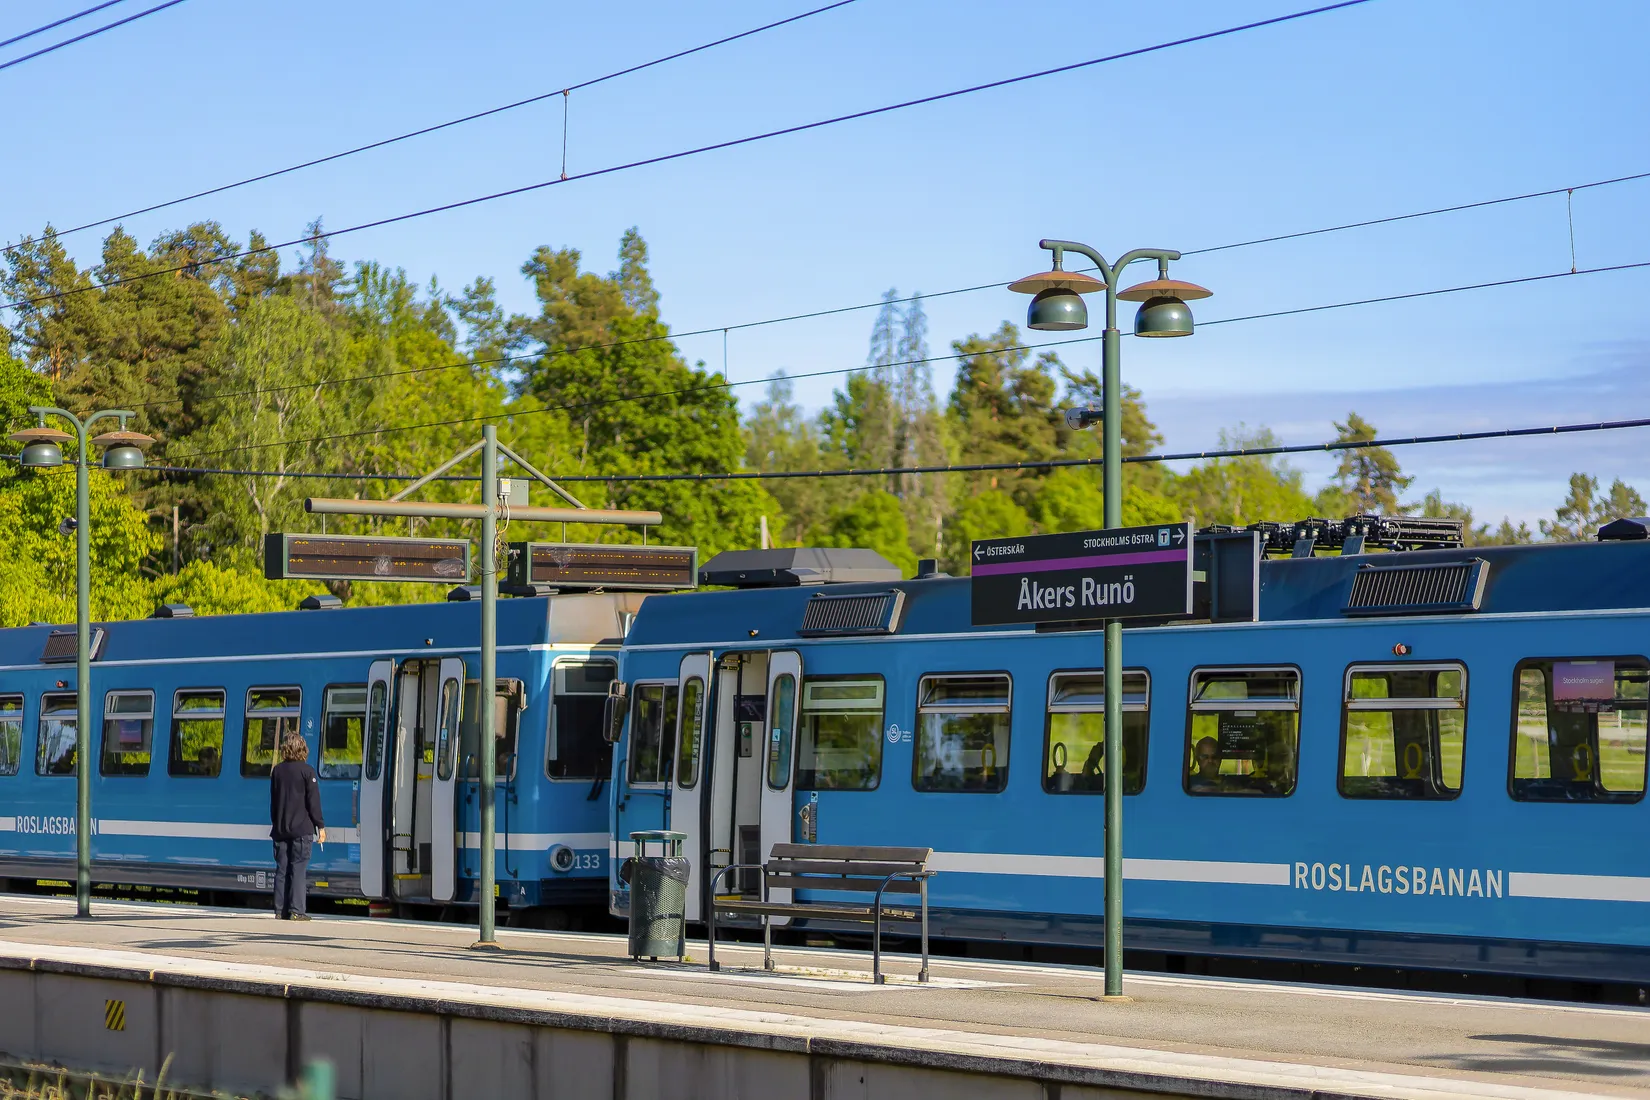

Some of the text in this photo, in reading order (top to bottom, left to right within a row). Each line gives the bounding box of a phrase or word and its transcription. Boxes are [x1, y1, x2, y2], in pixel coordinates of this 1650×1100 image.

[1083, 536, 1130, 548] STOCKHOLMS
[1131, 533, 1155, 545] ÖSTRA
[986, 543, 1025, 556] ÖSTERSKÄR
[1017, 575, 1135, 610] Åkers Runö
[17, 815, 97, 835] ROSLAGSBAN
[574, 854, 600, 869] 133
[1295, 862, 1503, 898] ROSLAGSBANAN
[520, 886, 526, 895] A
